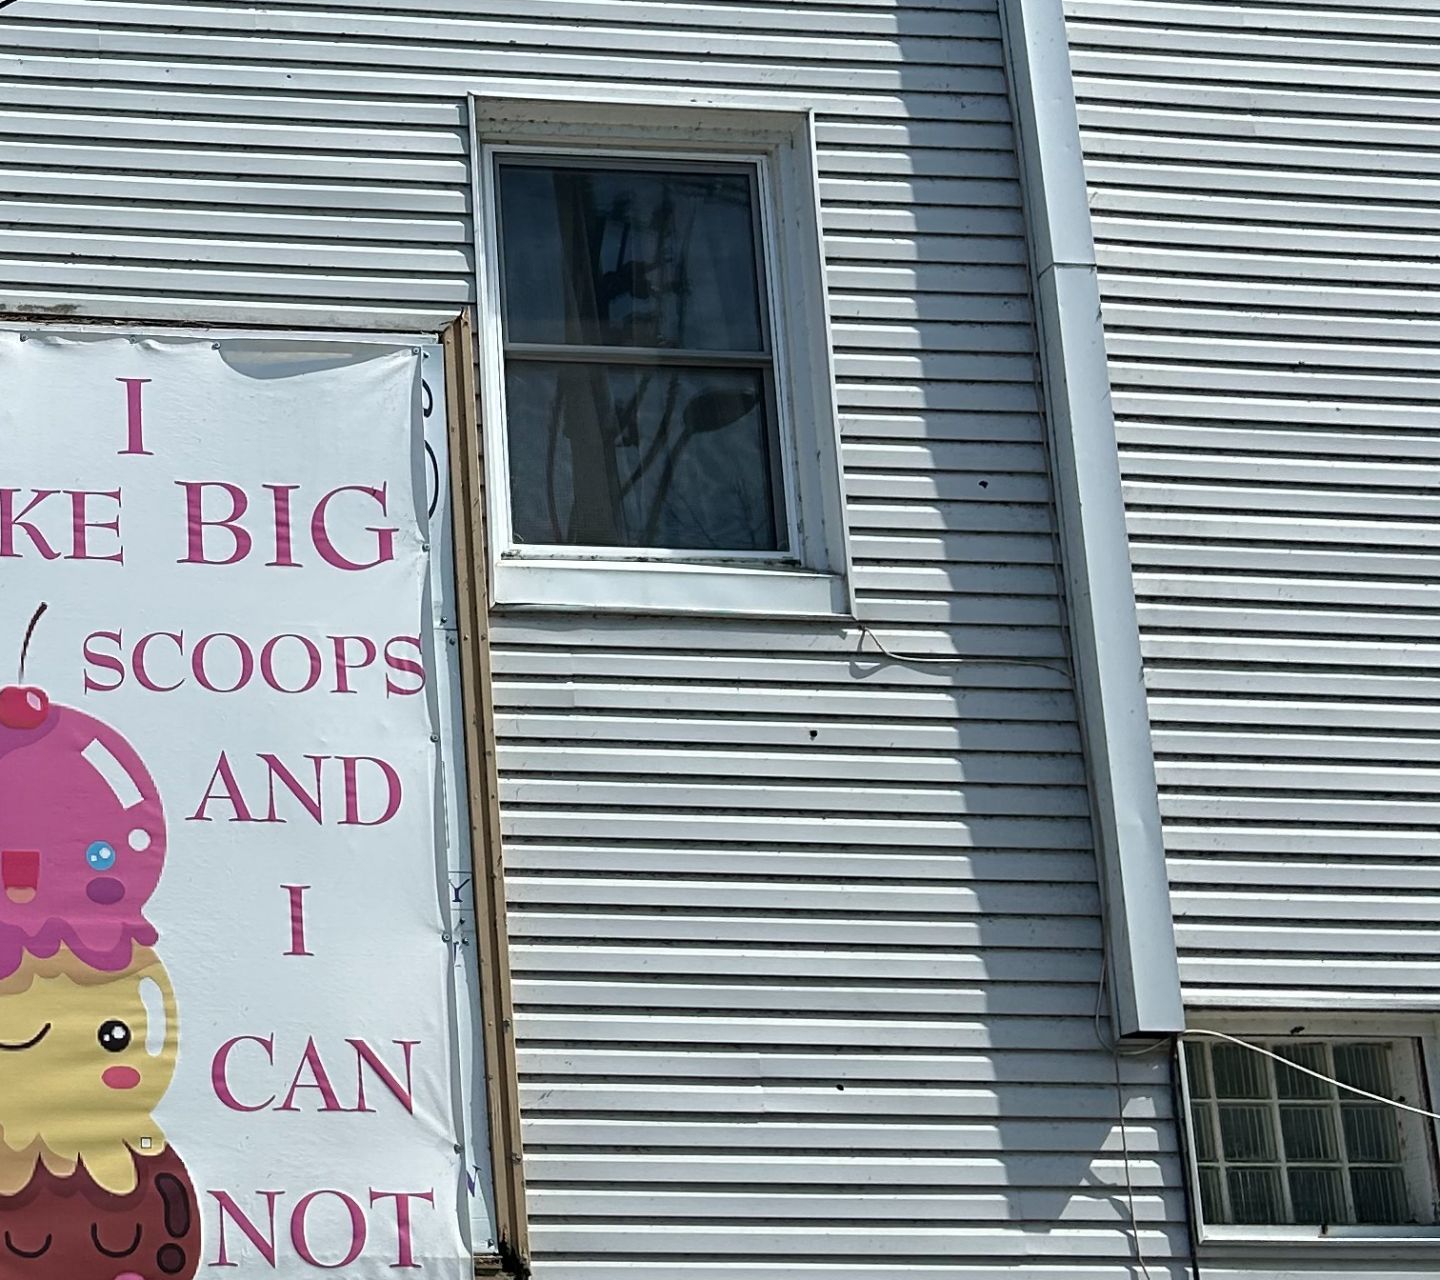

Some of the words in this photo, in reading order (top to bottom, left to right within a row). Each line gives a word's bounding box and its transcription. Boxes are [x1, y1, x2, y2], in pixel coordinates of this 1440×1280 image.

[115, 377, 154, 456] I
[174, 480, 400, 572] BIG
[82, 628, 427, 699] SCOOPS
[185, 750, 403, 826] AND
[279, 883, 313, 957] I
[211, 1033, 422, 1116] CAN
[206, 1186, 436, 1270] NOT
